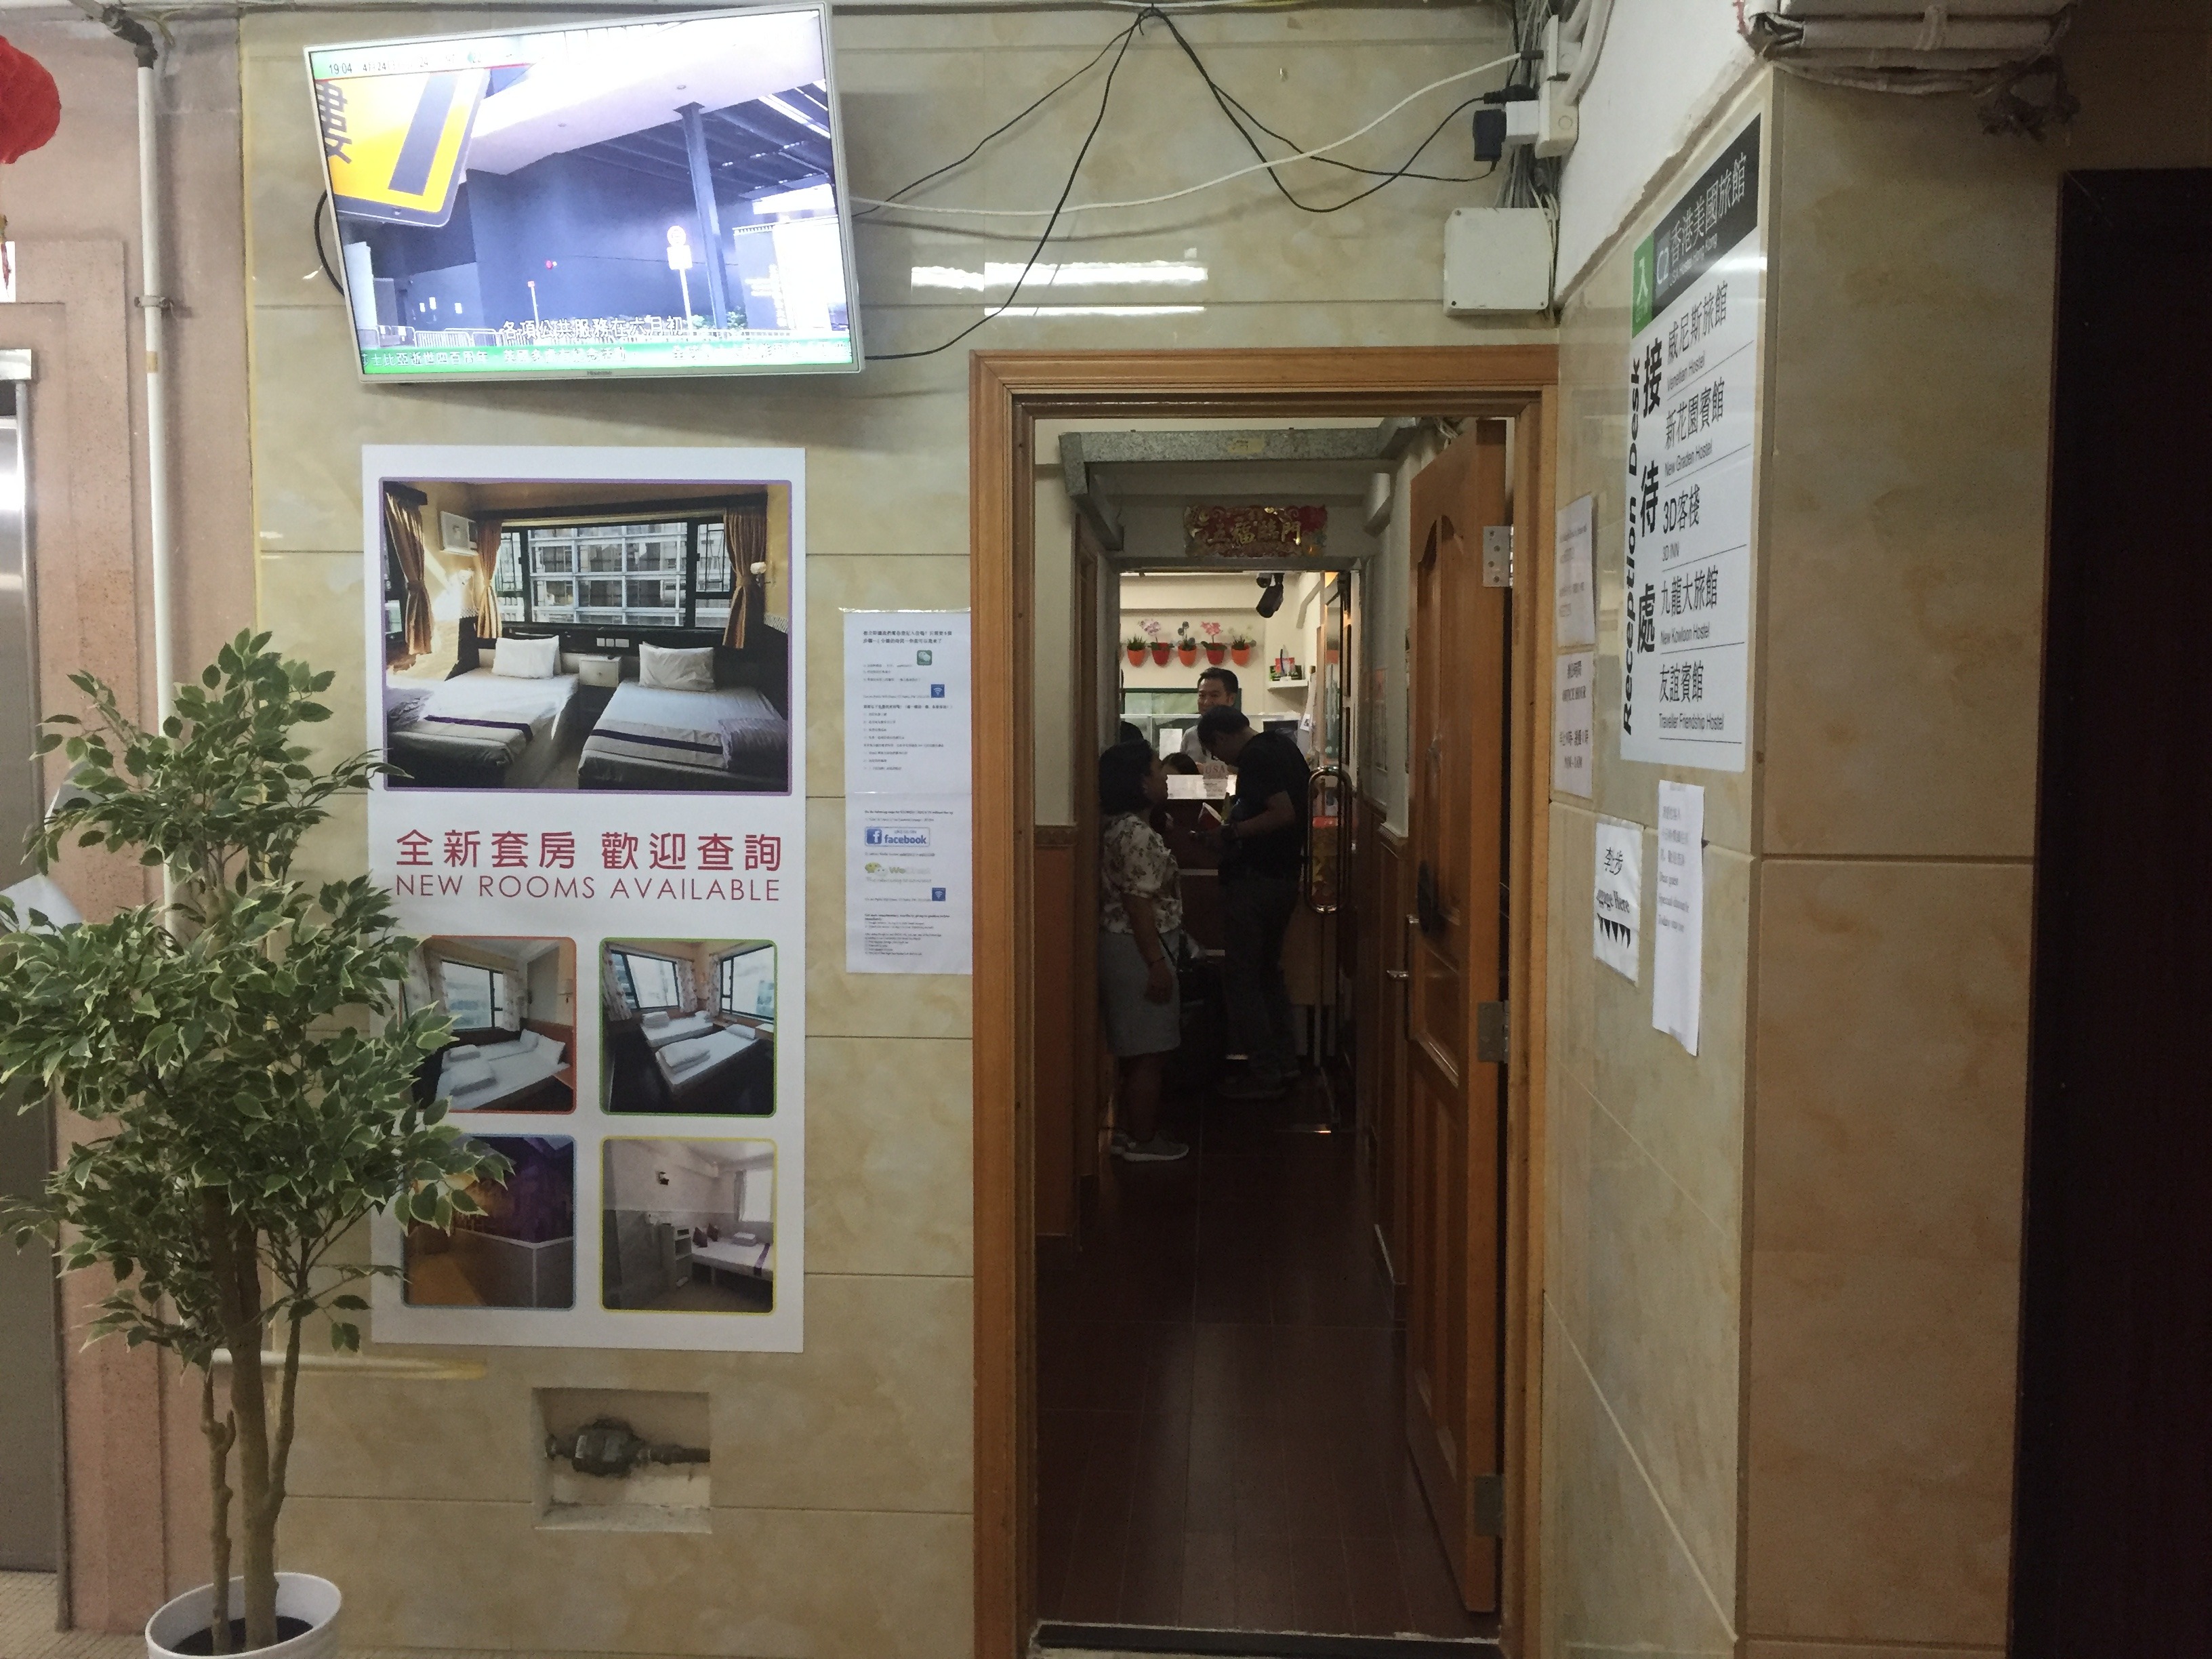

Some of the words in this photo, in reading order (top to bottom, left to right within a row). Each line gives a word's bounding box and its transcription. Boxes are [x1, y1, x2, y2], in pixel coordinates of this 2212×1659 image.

[1671, 152, 1746, 266] 香港美國旅館
[1668, 281, 1727, 365] 威尼斯旅館
[1688, 350, 1705, 377] Hostel
[1629, 357, 1640, 476] Desk
[1665, 377, 1725, 450] 新花園賓館
[1664, 462, 1675, 478] New
[1694, 438, 1713, 462] Hostel
[1661, 565, 1719, 617] 九龍大旅館
[1623, 495, 1636, 736] Reception
[1661, 629, 1671, 644] New
[1671, 626, 1692, 643] Kowloon
[1693, 621, 1711, 640] Hostel
[1660, 659, 1704, 703] 友誼賓館
[1679, 712, 1705, 731] Friendship
[1706, 712, 1724, 731] Hostel
[396, 829, 575, 868] 全新套房
[601, 832, 781, 872] 歡迎查詢
[884, 834, 926, 844] facebook
[396, 874, 463, 897] NEW
[478, 875, 595, 899] ROOMS
[610, 878, 779, 901] AVAILABLE
[1613, 890, 1631, 914] Here
